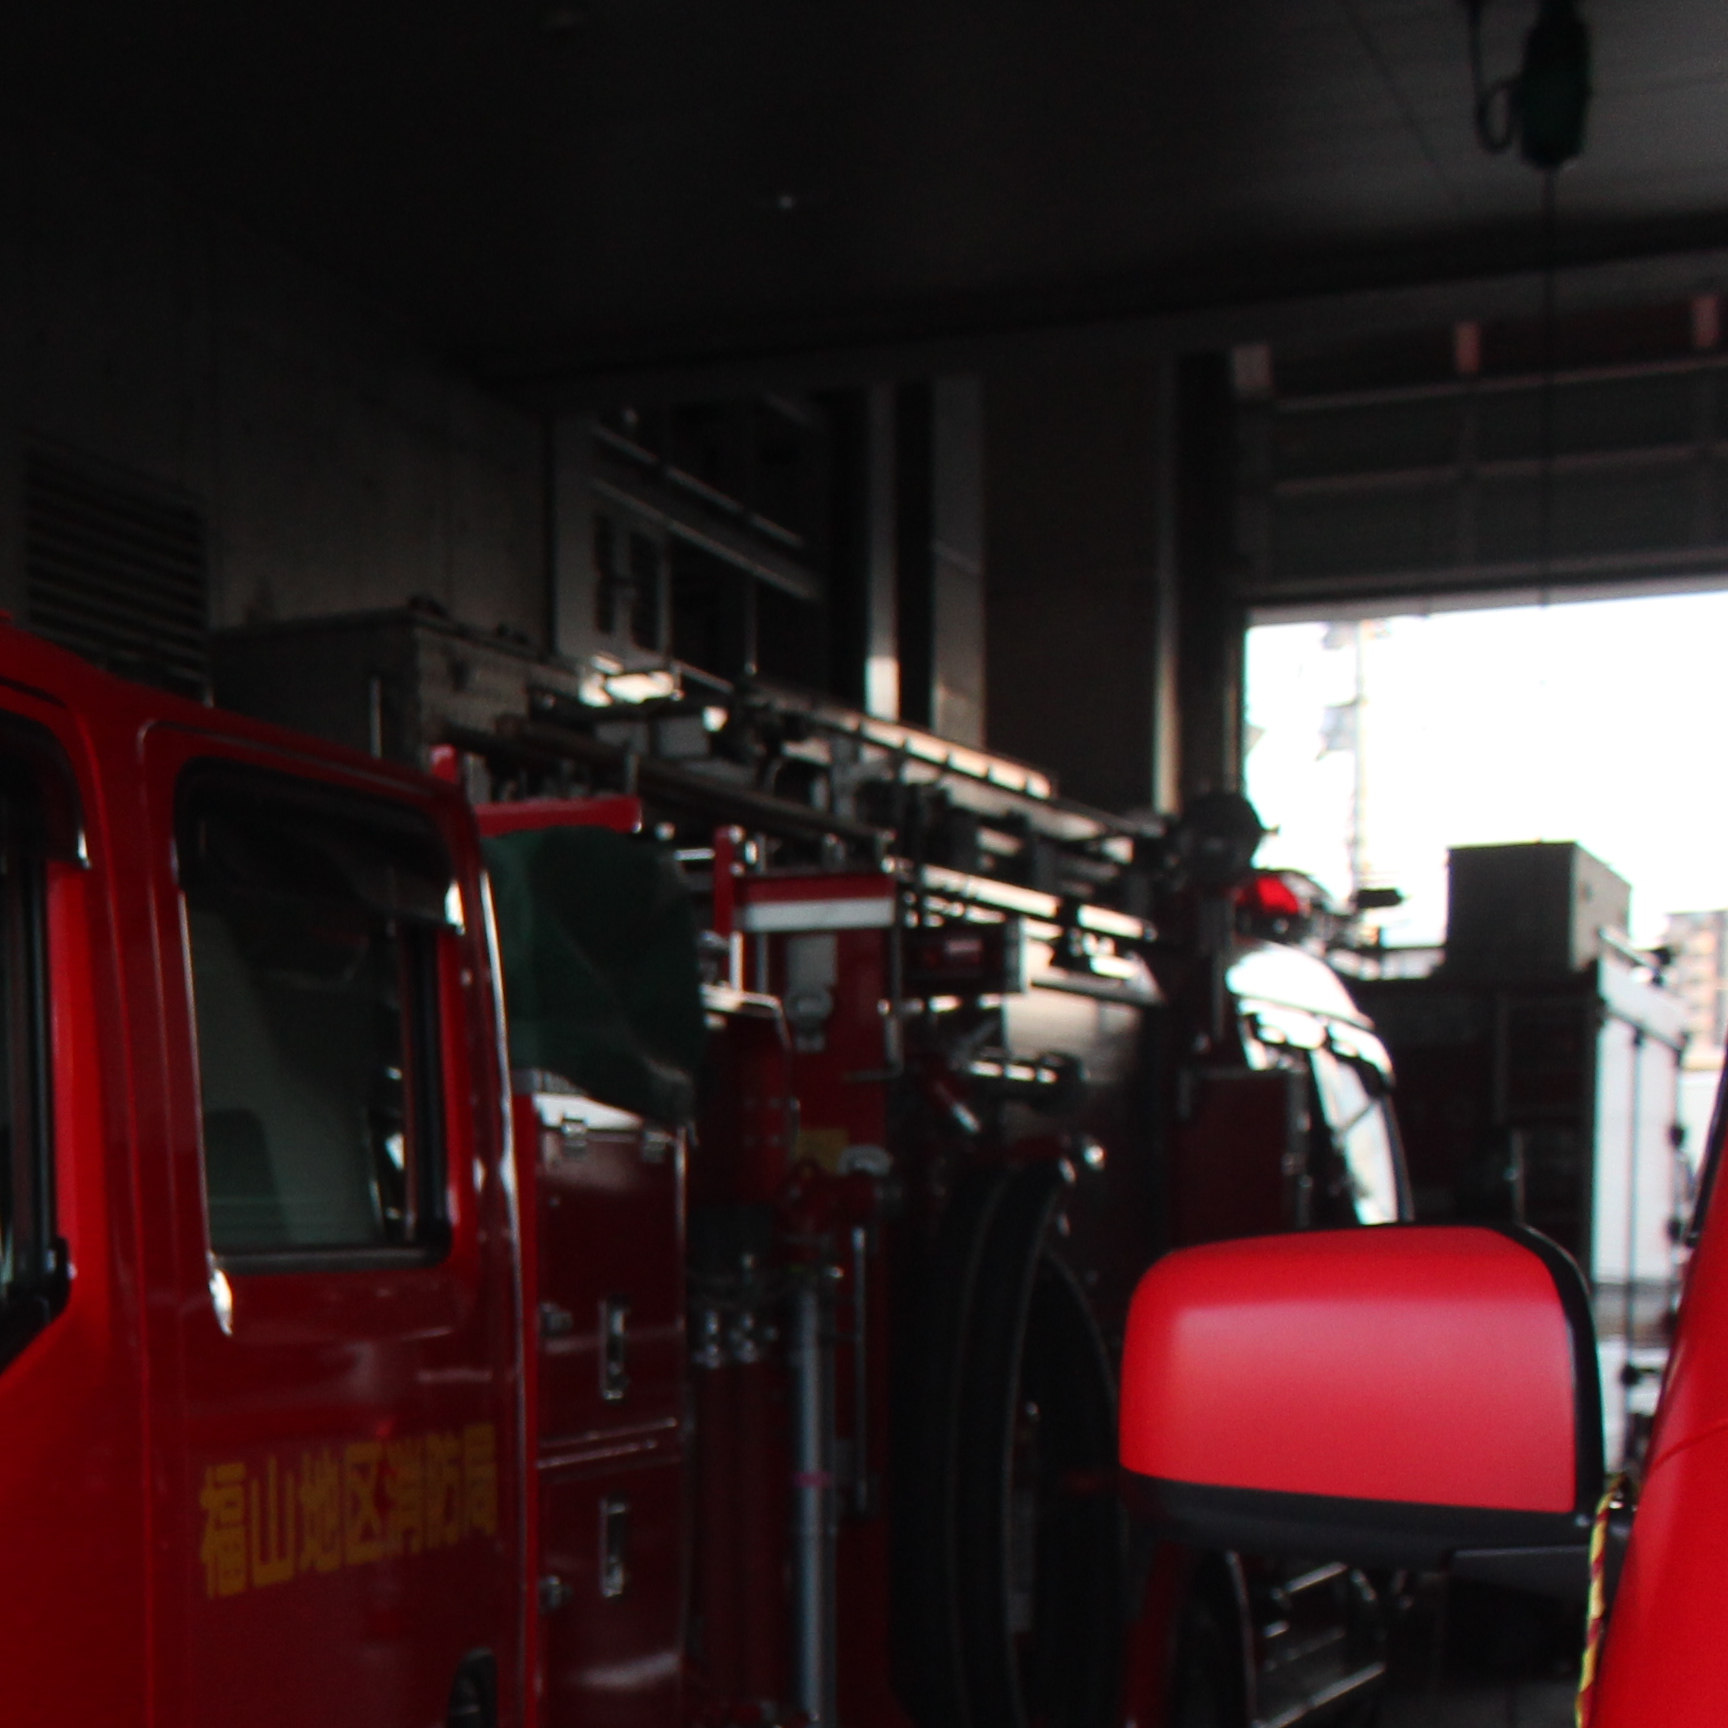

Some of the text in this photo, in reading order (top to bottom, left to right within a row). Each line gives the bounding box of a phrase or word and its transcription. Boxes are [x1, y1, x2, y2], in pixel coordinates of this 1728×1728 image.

[200, 1423, 497, 1598] 福山地区消防局
